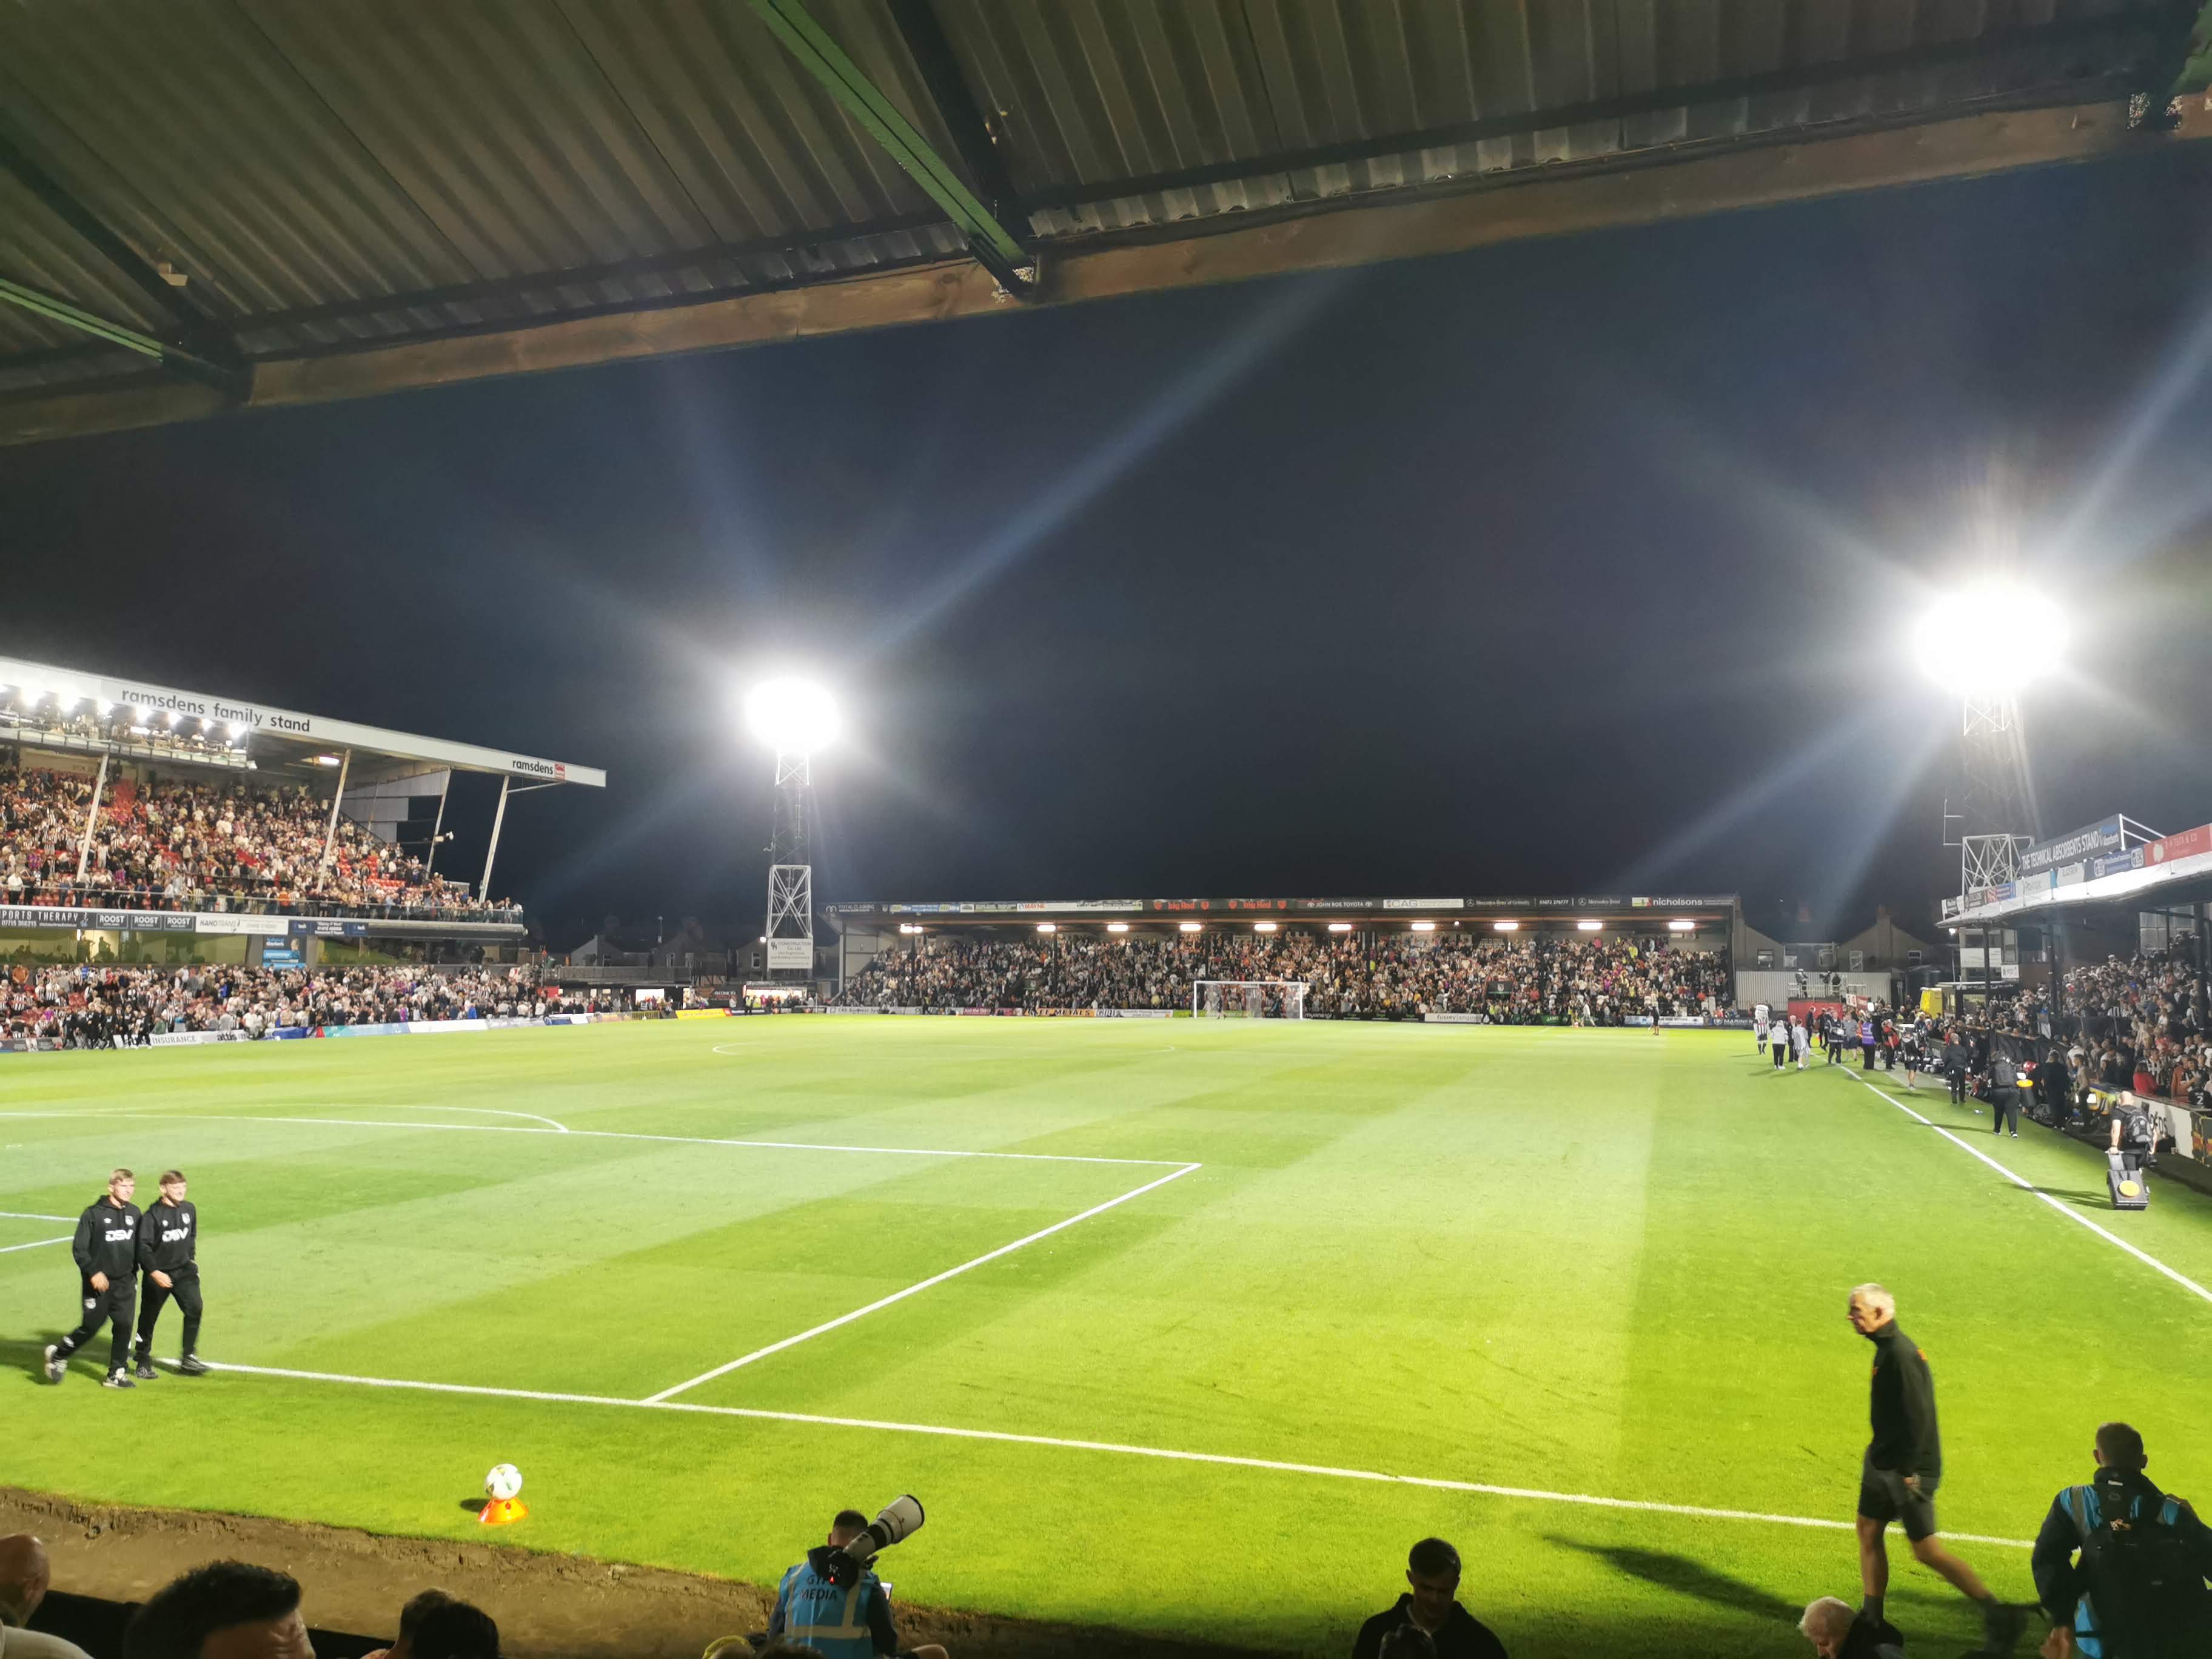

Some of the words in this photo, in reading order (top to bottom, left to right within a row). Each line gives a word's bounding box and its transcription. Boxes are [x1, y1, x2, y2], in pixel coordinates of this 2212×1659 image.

[122, 689, 205, 714] ramsdens
[213, 703, 262, 726] family
[270, 715, 310, 732] stand
[512, 760, 554, 775] ramsdens
[2022, 855, 2031, 870] THE
[2081, 830, 2100, 852] STAND
[1653, 897, 1703, 906] nicholsons
[0, 910, 32, 920] PORTS
[38, 911, 79, 922] THERAPY
[99, 915, 126, 923] ROOST
[167, 917, 191, 925] ROOST
[152, 1036, 196, 1045] INSURANCE
[216, 1033, 237, 1042] attis
[799, 1587, 838, 1601] MEDIA
